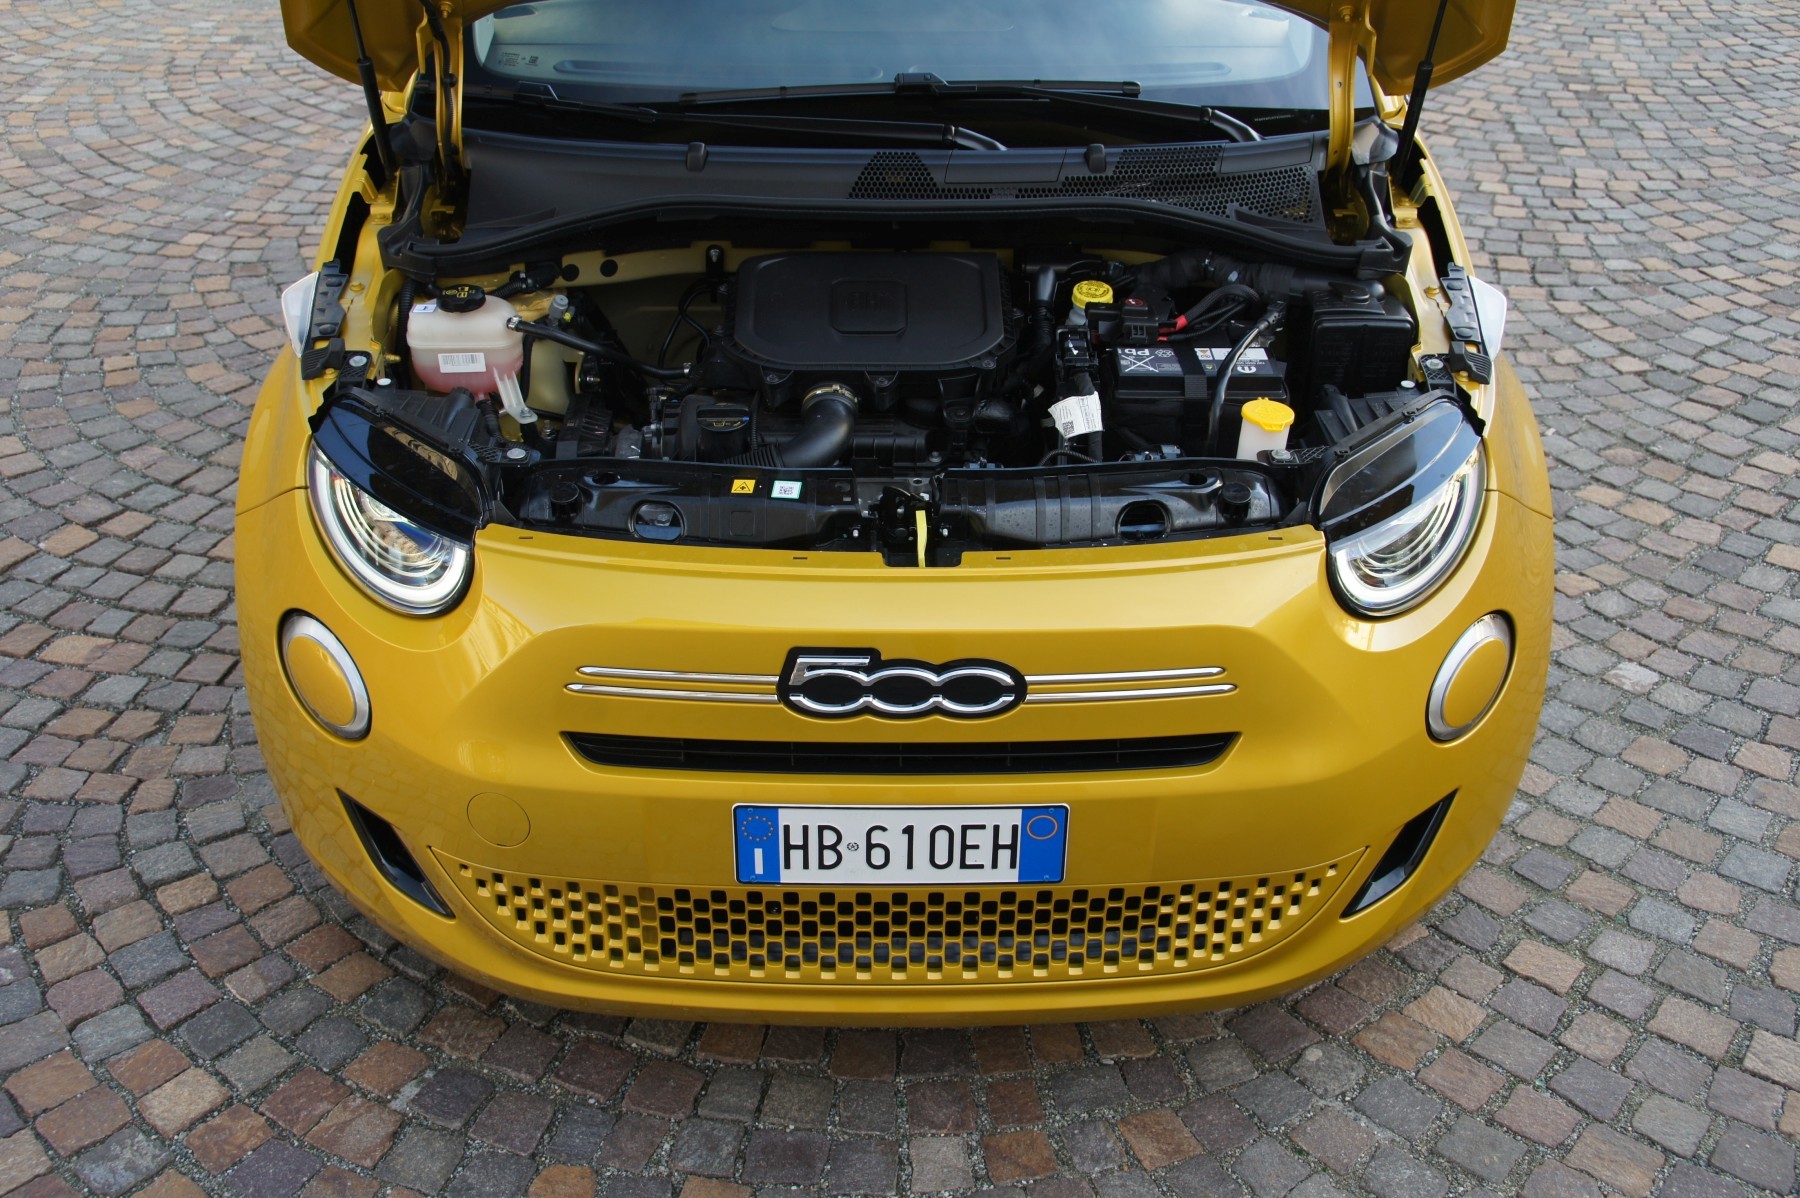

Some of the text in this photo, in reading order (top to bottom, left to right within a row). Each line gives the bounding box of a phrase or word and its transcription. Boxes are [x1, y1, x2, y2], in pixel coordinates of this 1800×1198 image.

[1124, 348, 1150, 356] Pb
[789, 655, 1015, 714] 500
[783, 824, 1019, 870] HB 610EH
